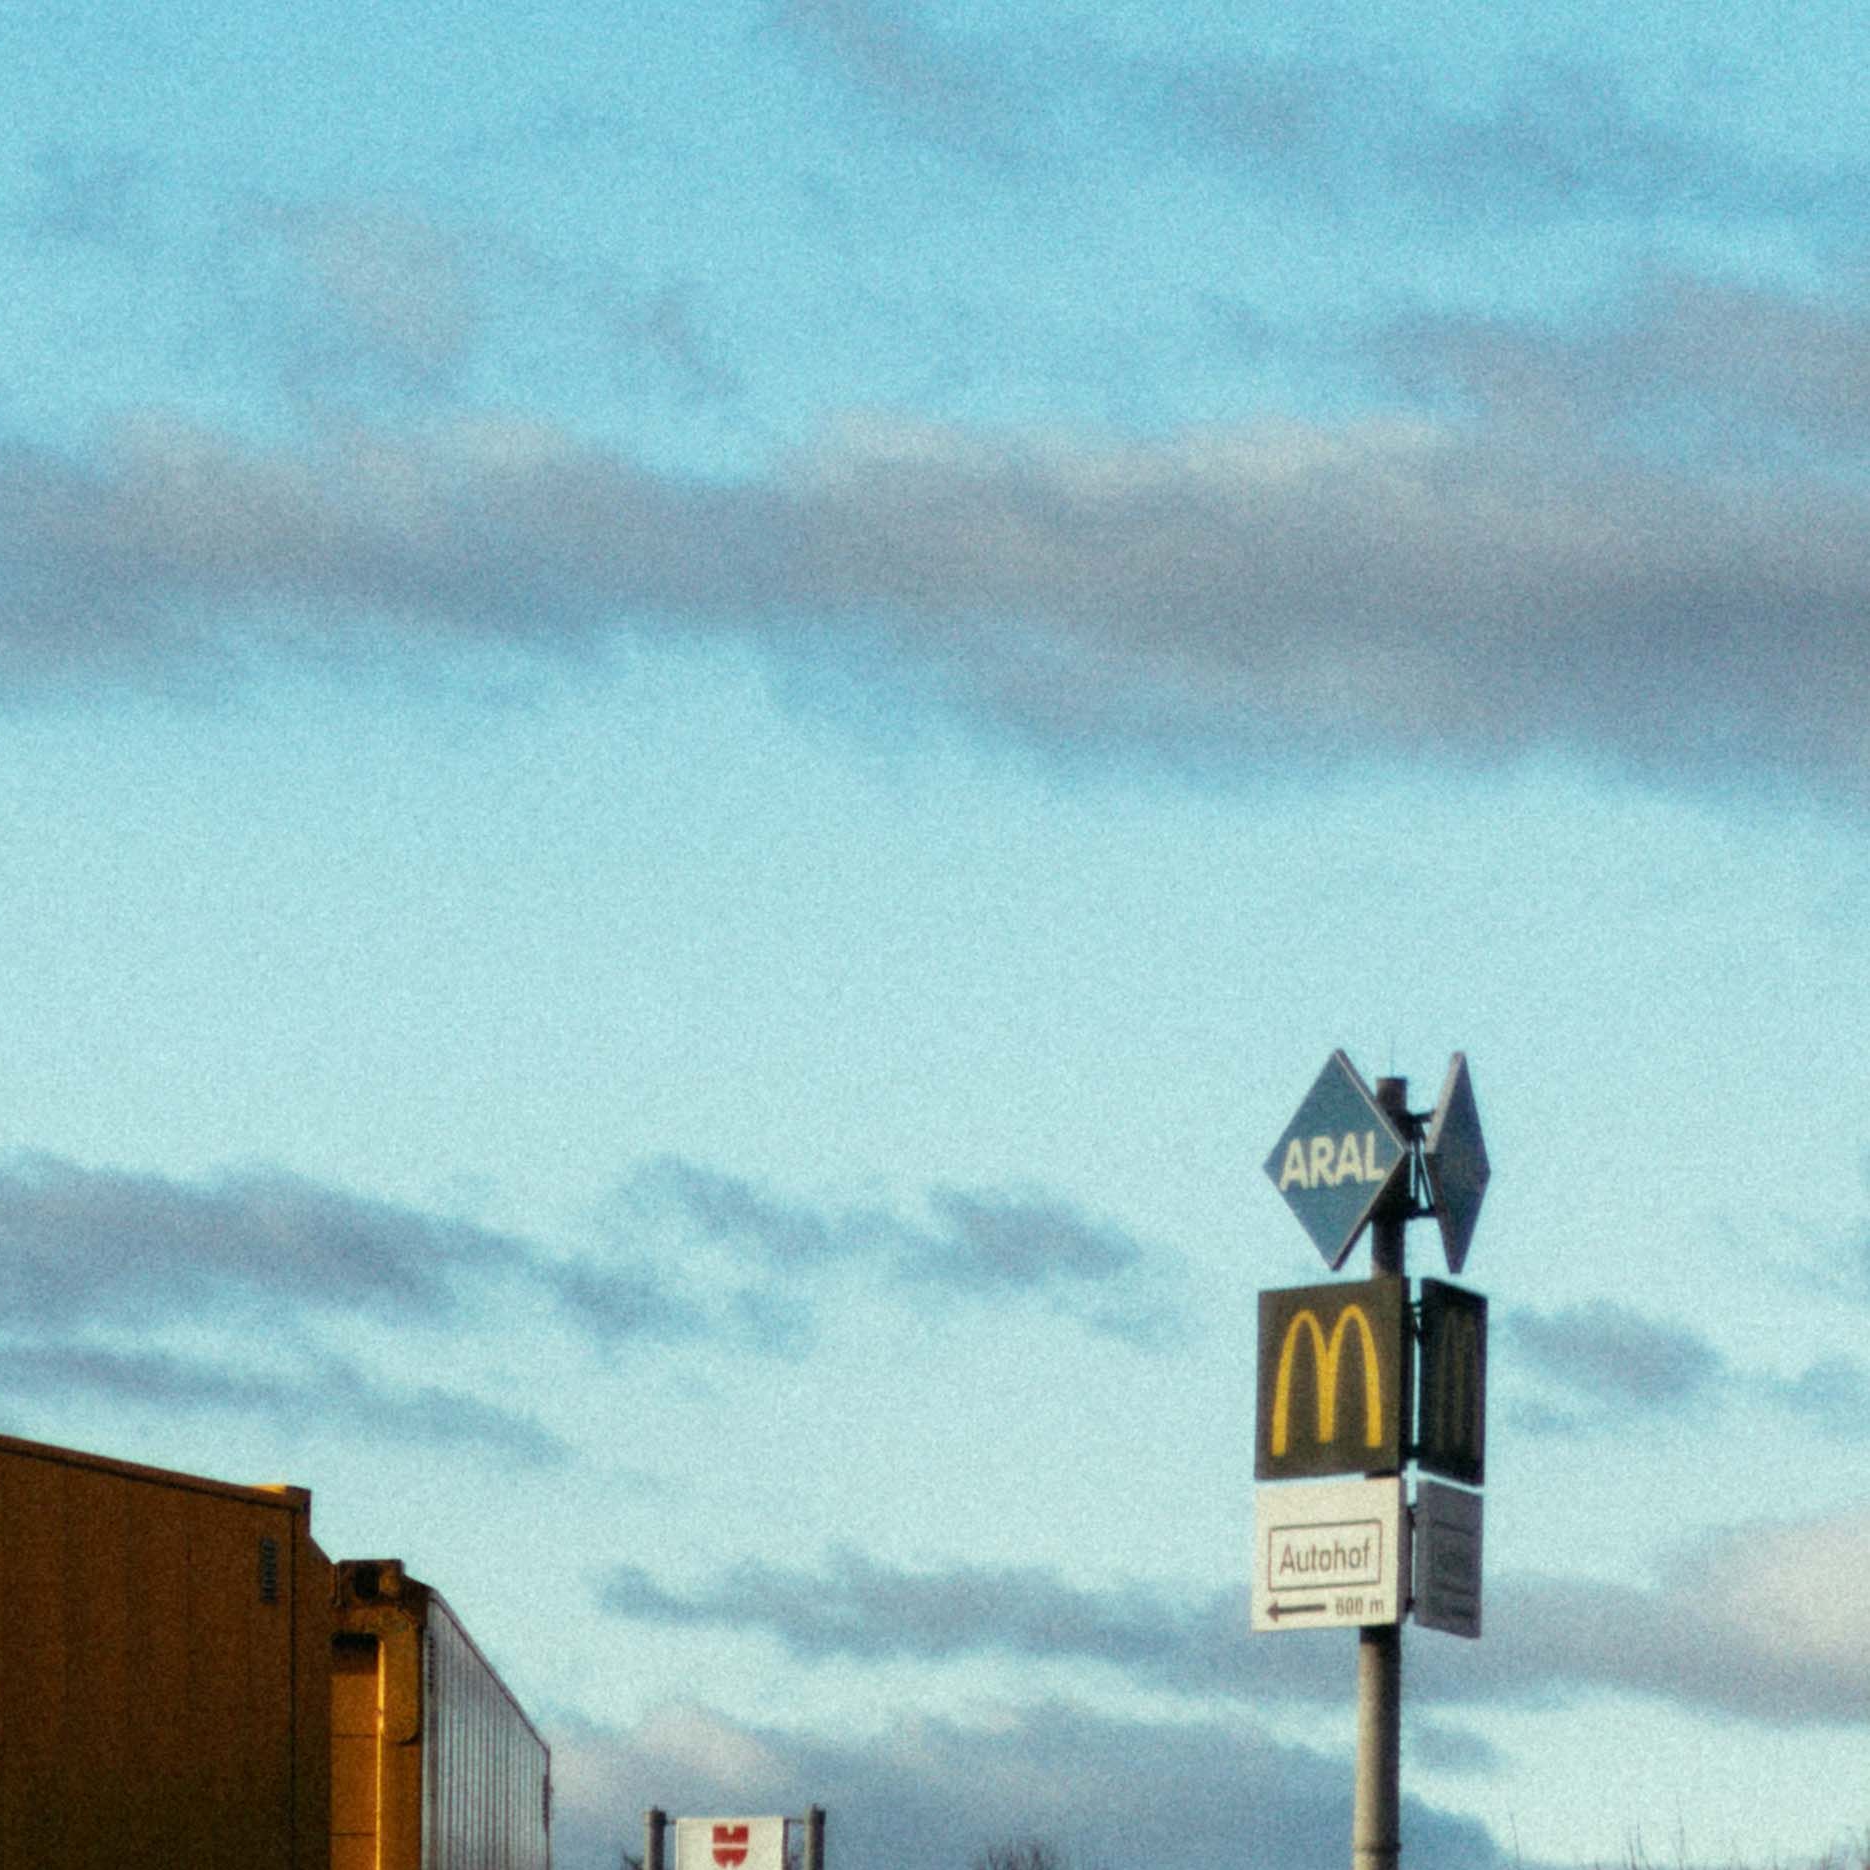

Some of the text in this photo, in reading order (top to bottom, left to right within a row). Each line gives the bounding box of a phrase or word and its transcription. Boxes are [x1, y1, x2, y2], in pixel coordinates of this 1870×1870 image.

[1279, 1130, 1385, 1191] ARAL
[1279, 1536, 1371, 1576] Autohof
[1369, 1600, 1385, 1616] m
